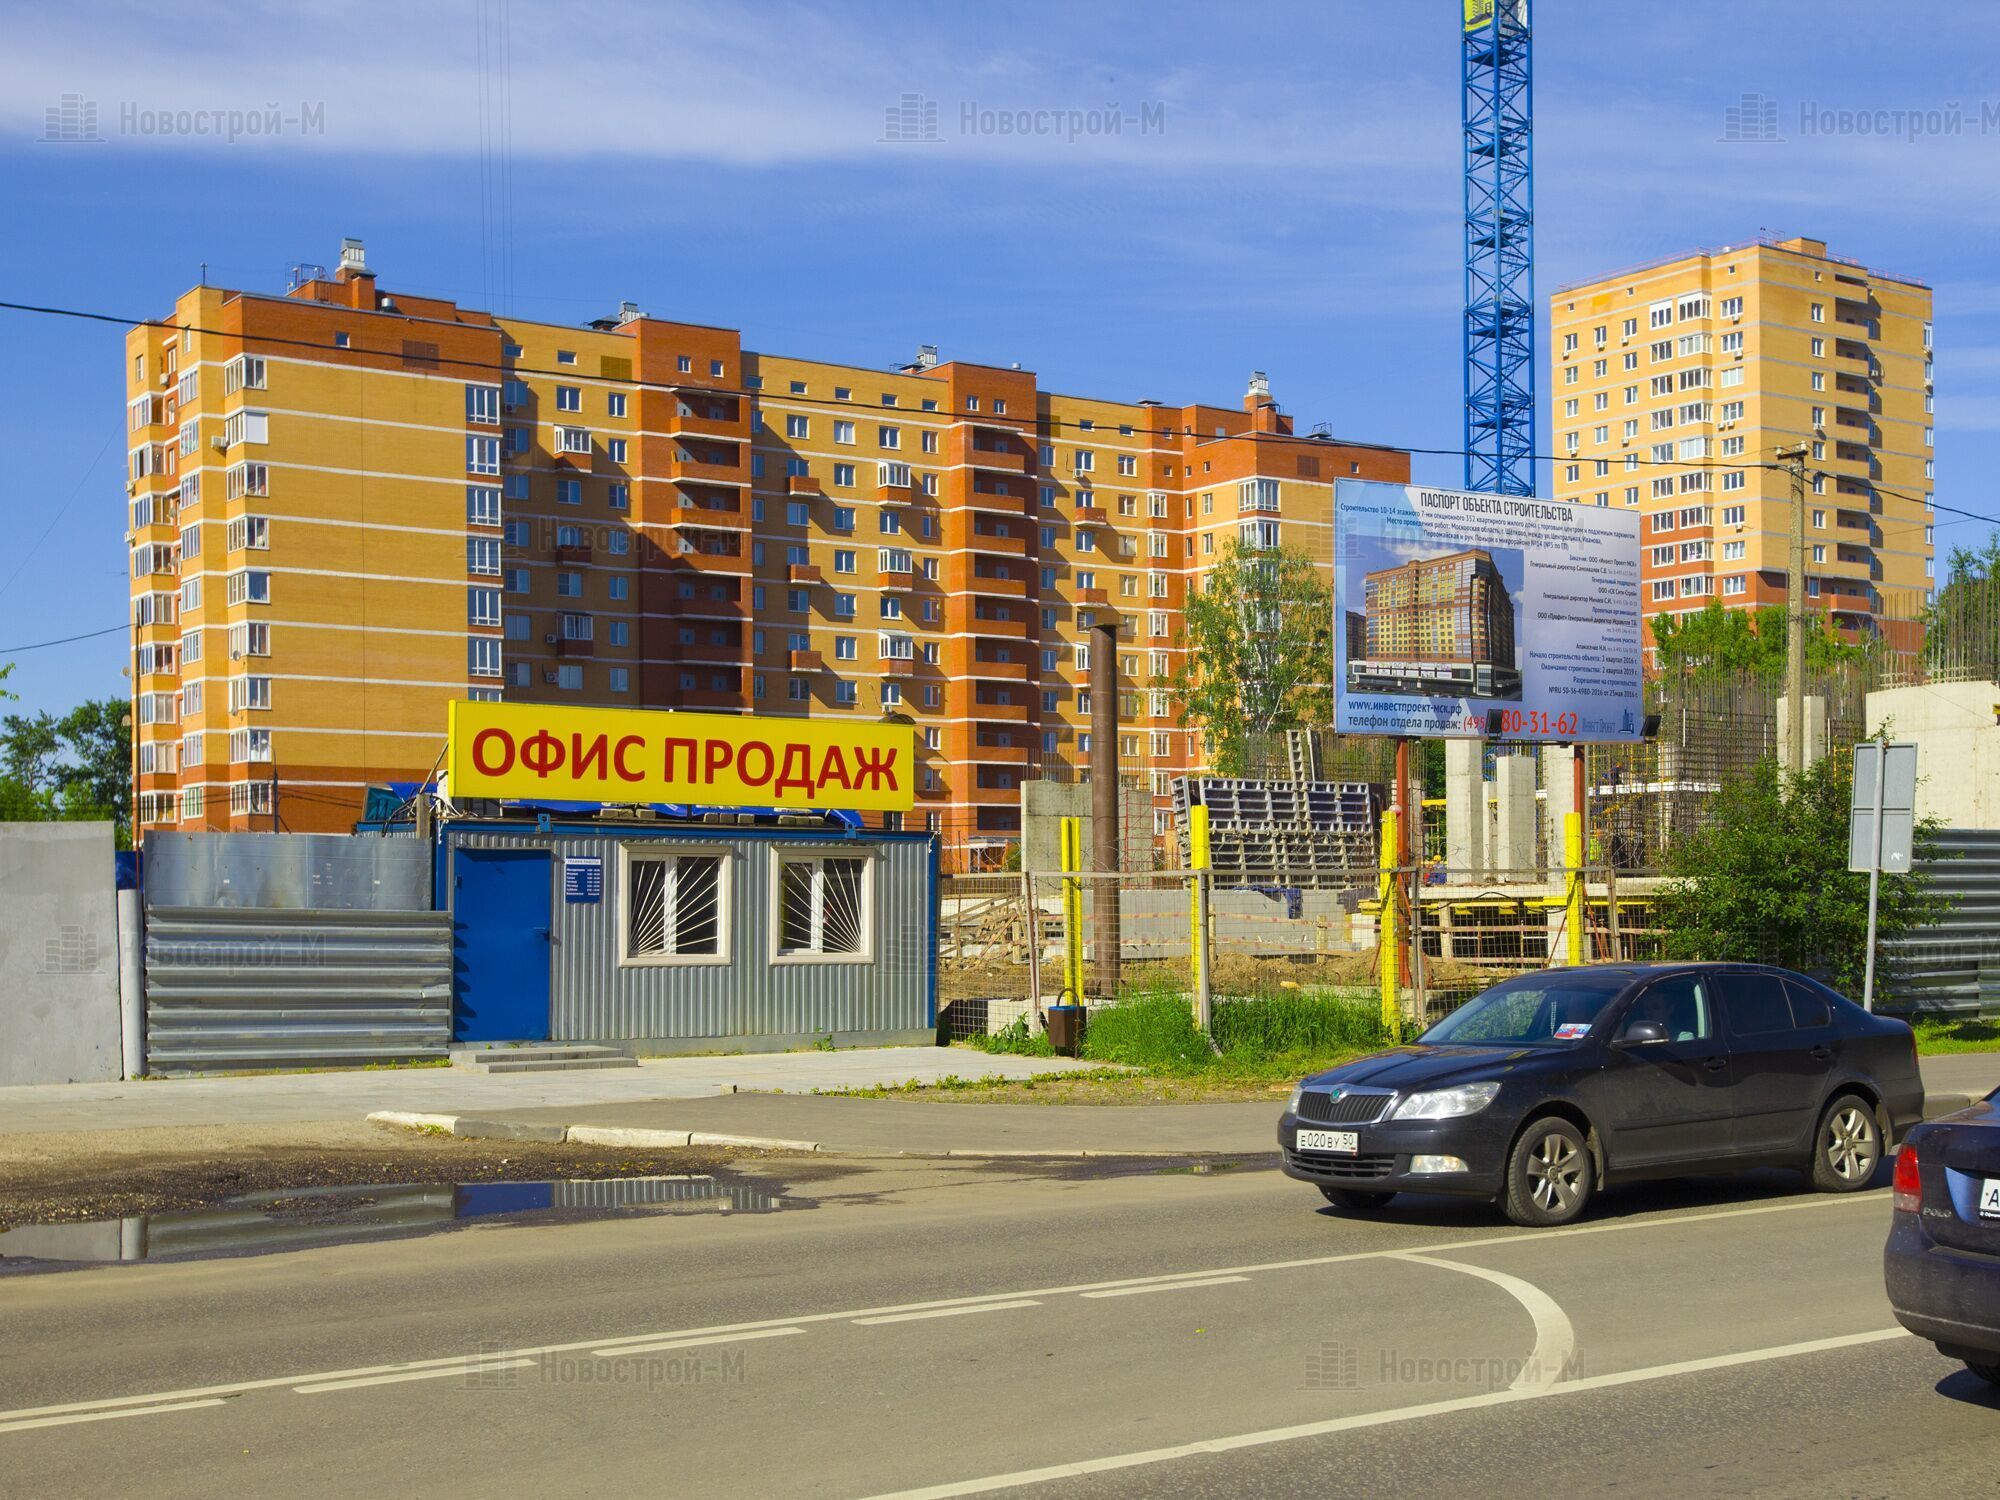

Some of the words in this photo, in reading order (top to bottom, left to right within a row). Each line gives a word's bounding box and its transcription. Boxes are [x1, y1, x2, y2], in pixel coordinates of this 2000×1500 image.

[1340, 502, 1378, 514] Строительство
[1380, 506, 1395, 514] 10-14
[1397, 509, 1419, 517] этажного
[1476, 517, 1505, 526] квартирного
[1420, 492, 1460, 510] ПАСПОРТ
[1462, 496, 1501, 514] ОБЪЕКТА
[1504, 501, 1572, 521] СТРОИТЕЛЬСТВА
[1403, 519, 1432, 528] проведения
[1451, 523, 1479, 531] Московская
[1423, 529, 1459, 538] Первомайская
[1548, 653, 1580, 661] строительства
[1541, 662, 1567, 671] Окончание
[1606, 667, 1622, 675] квартал
[1348, 699, 1462, 715] www.инвестпроект-мск.рф
[1348, 713, 1387, 727] телефон
[1390, 716, 1421, 728] отдела
[1424, 718, 1460, 731] продаж:
[1463, 715, 1486, 732] (495
[1502, 709, 1579, 735] 80-31-62
[472, 728, 645, 782] ОФИС
[664, 736, 898, 799] ПРОДАЖ
[1300, 1132, 1340, 1148] Е020ВУ
[1343, 1133, 1354, 1146] 50
[1988, 1188, 1999, 1208] А
[1922, 1206, 1952, 1218] POLO
